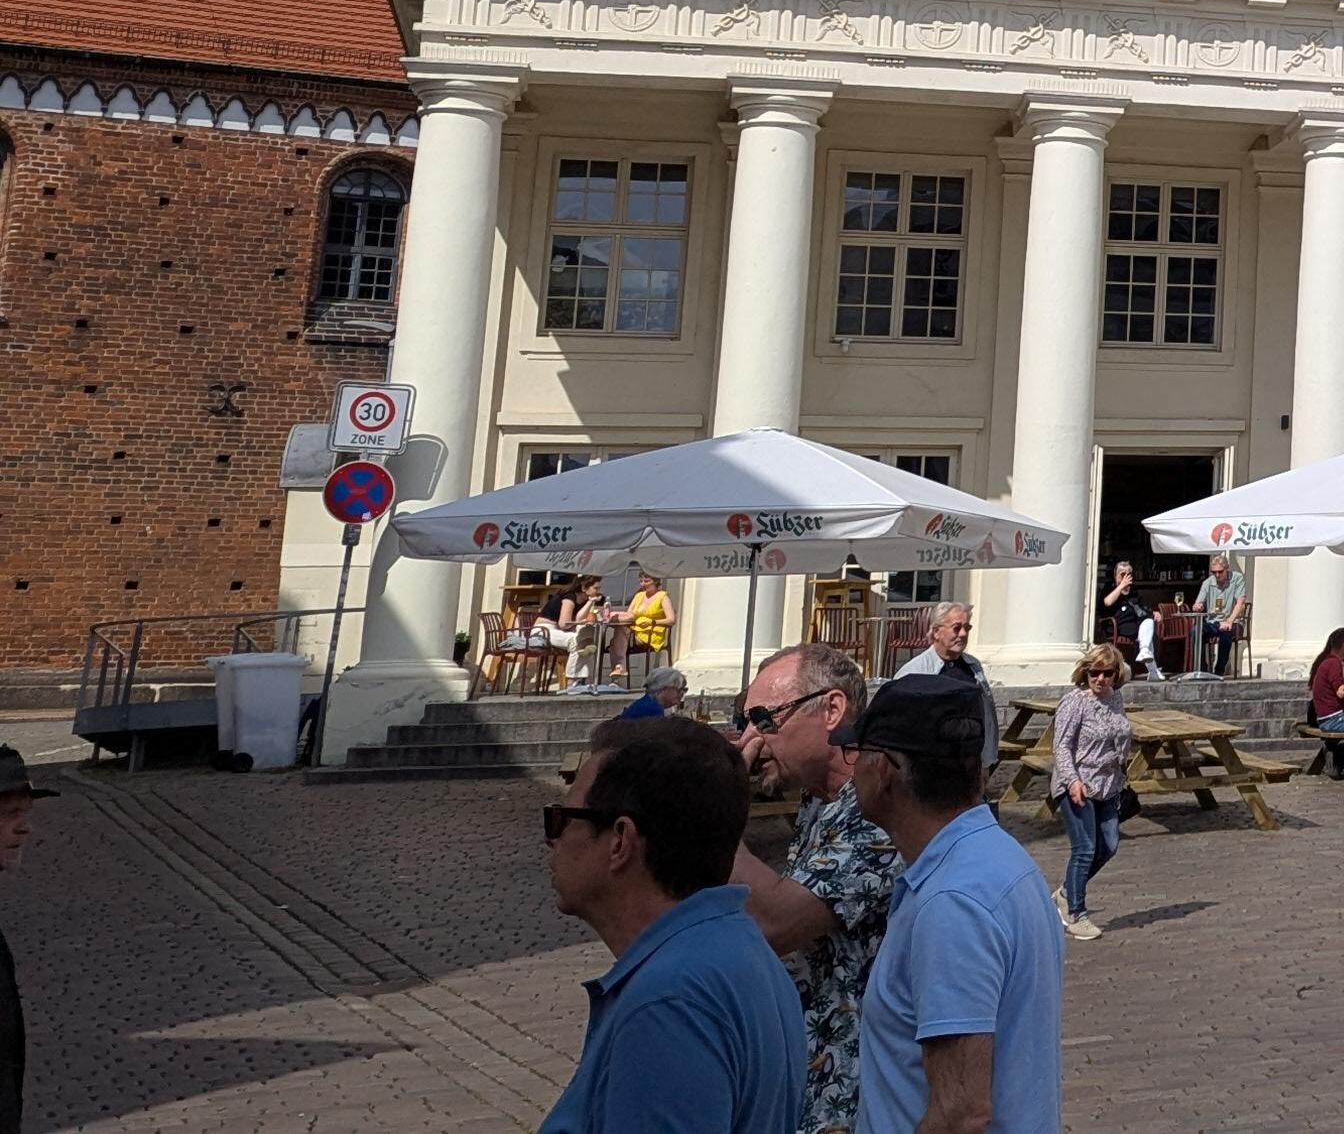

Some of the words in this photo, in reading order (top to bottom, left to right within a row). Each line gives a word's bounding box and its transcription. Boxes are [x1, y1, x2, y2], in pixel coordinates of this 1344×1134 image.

[358, 402, 387, 422] 30
[350, 434, 387, 446] ZONE
[501, 520, 573, 550] Lübzer
[756, 511, 824, 538] Lübzer
[1233, 521, 1294, 546] Lübzer
